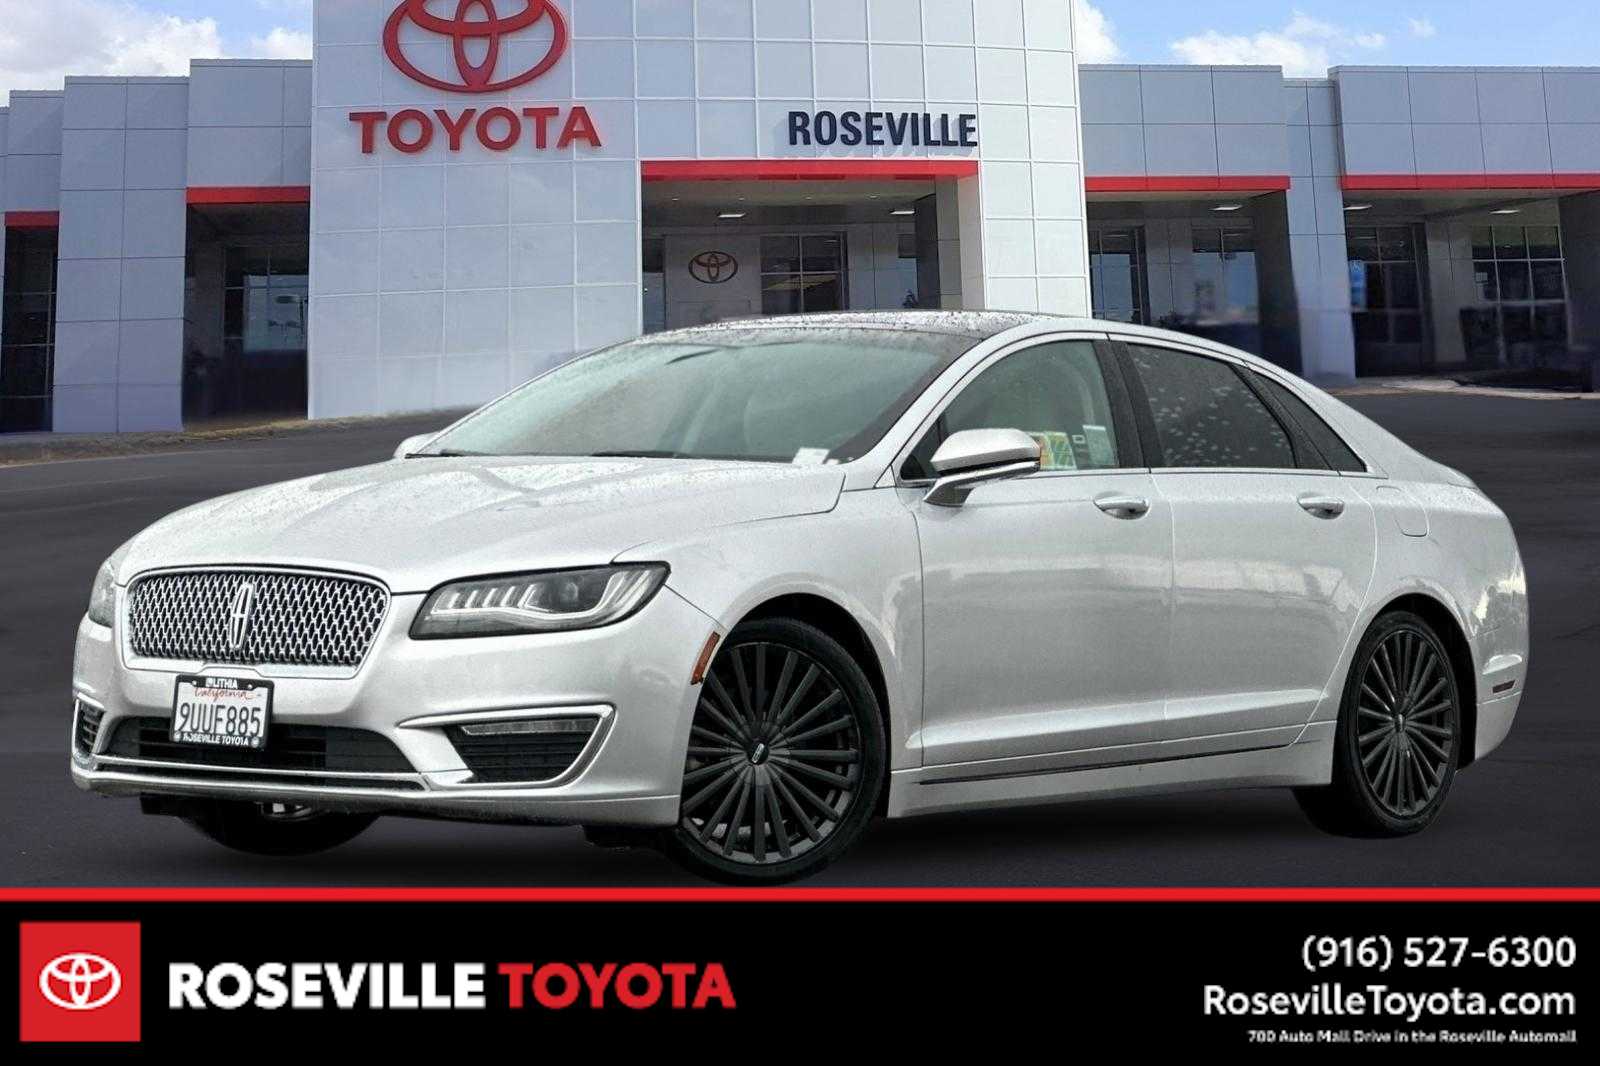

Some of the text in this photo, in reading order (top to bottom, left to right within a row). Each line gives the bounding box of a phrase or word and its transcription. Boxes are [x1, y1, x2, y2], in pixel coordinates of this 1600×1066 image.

[349, 106, 602, 154] TOYOTA
[788, 111, 978, 147] ROSEVILLE
[177, 702, 262, 737] 9UUF885
[221, 735, 249, 746] TOYOTA
